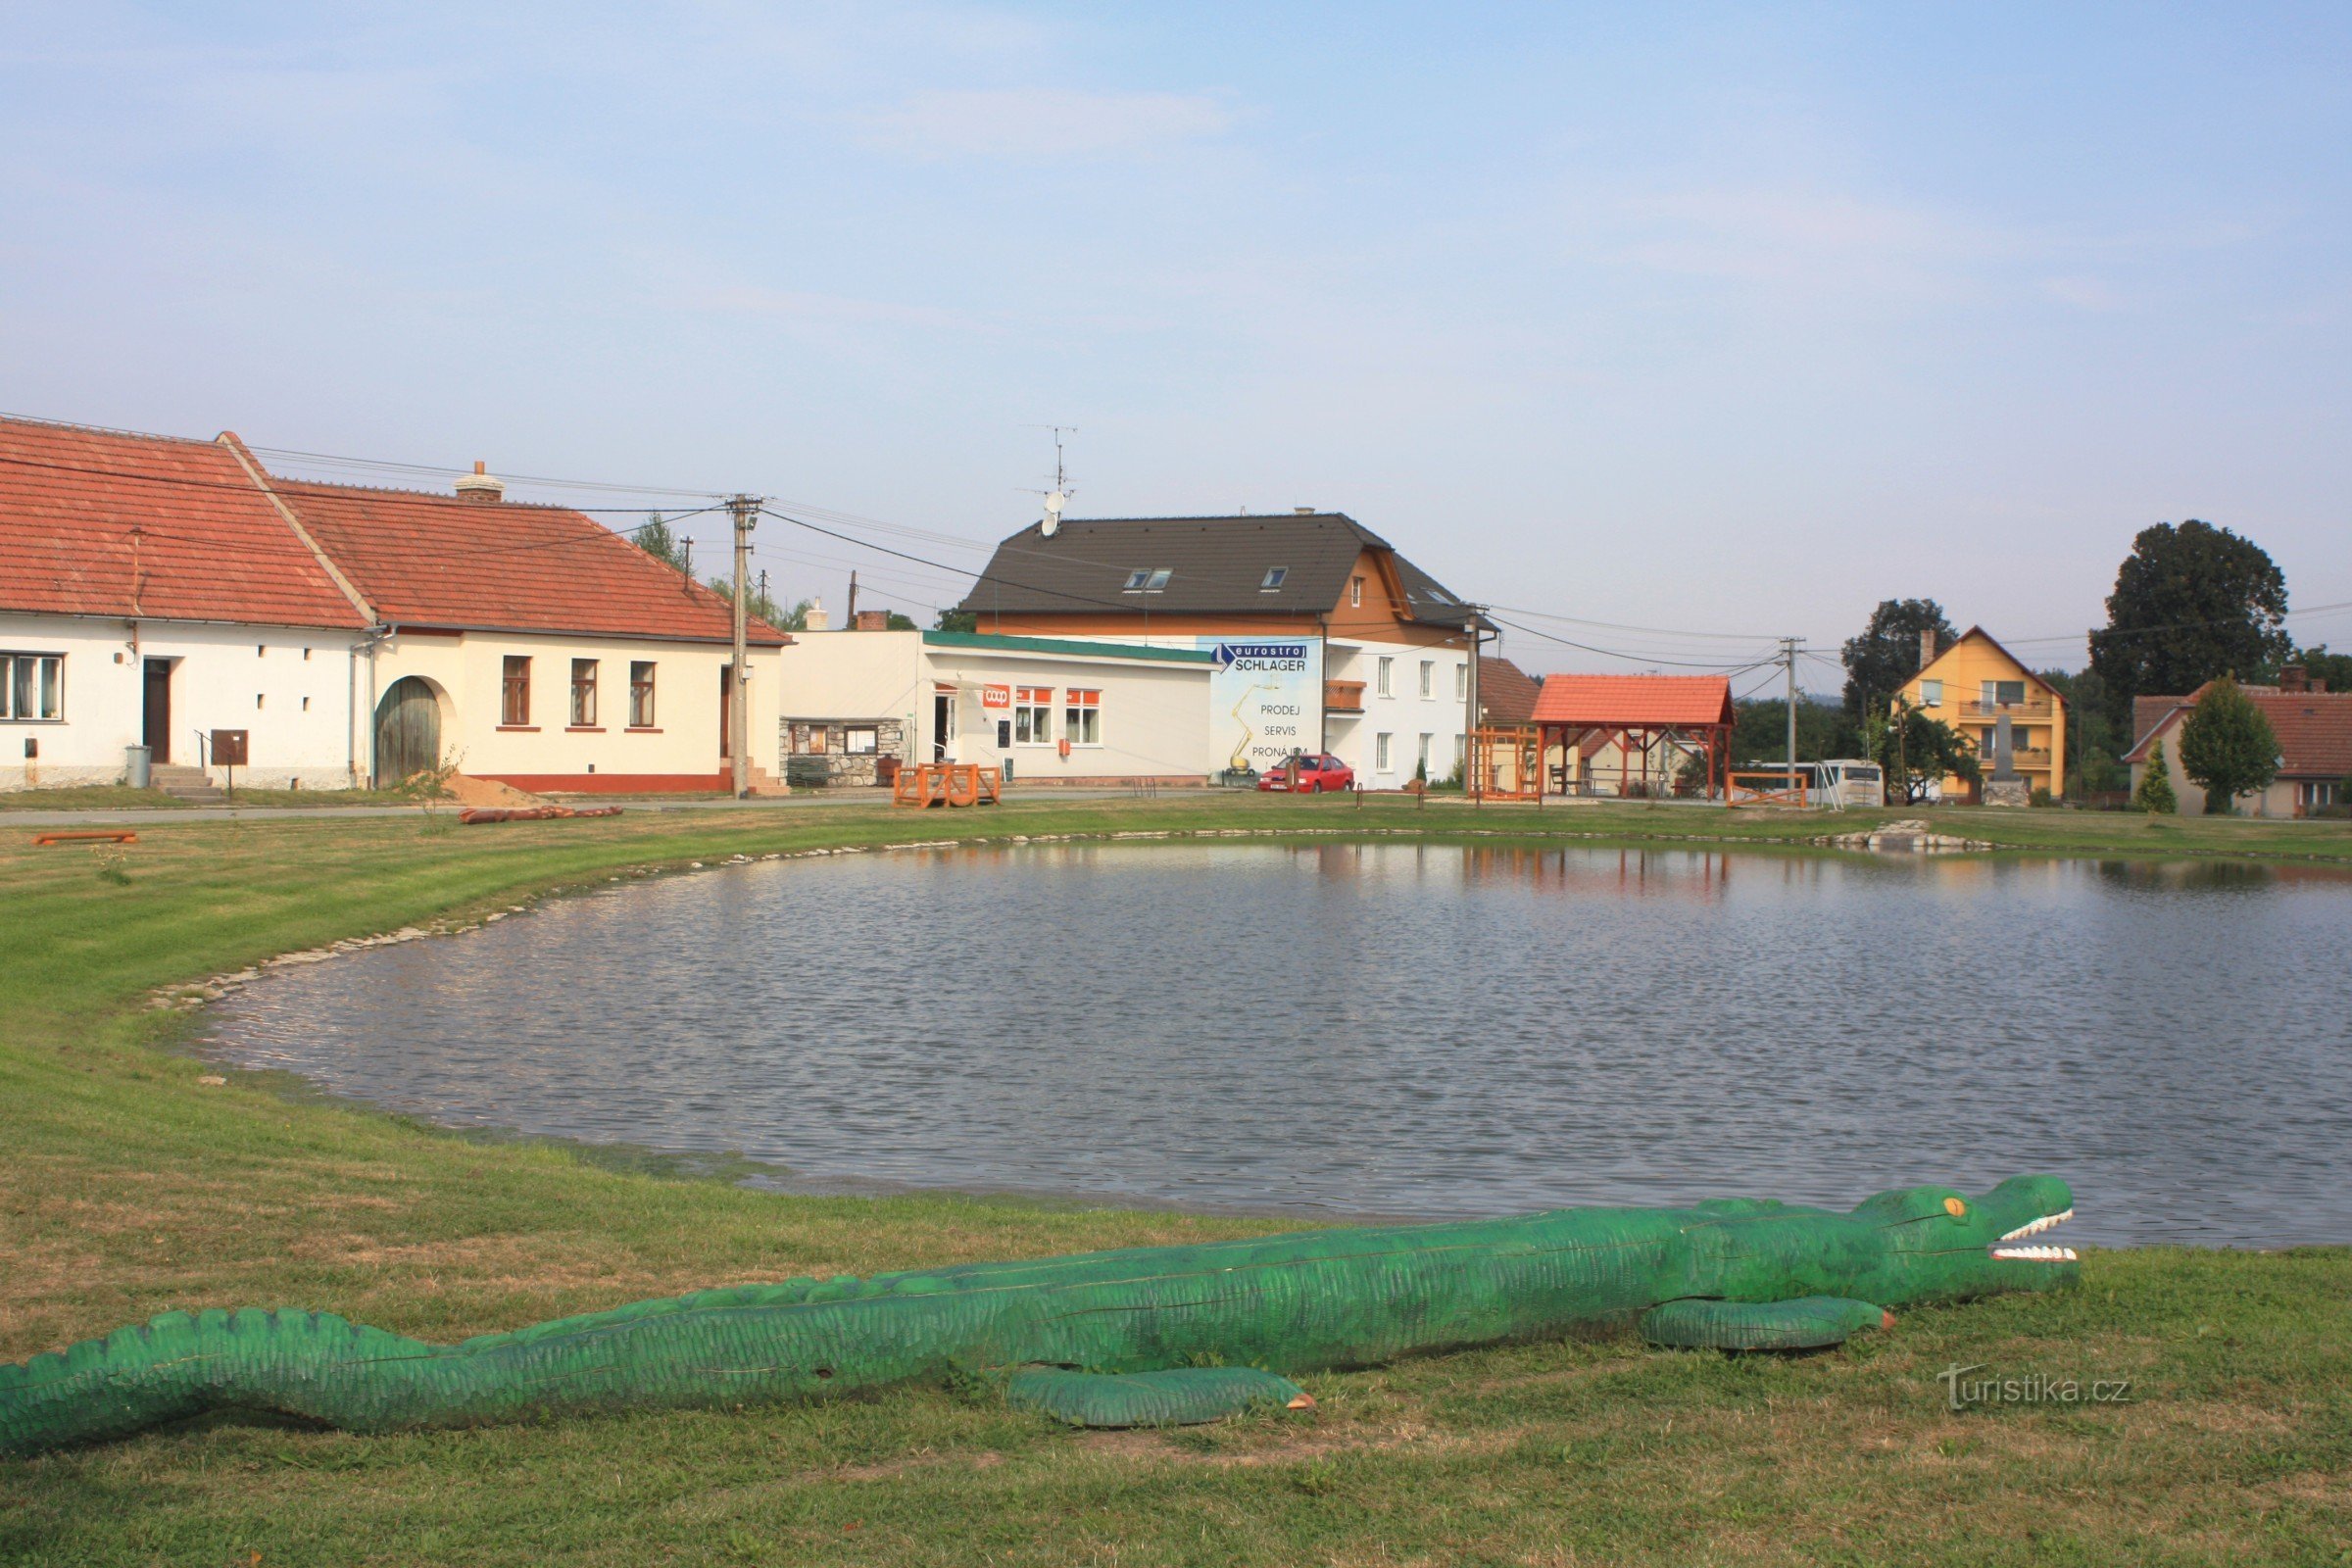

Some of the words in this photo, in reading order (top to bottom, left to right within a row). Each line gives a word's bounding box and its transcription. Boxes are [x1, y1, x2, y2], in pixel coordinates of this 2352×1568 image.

[1235, 646, 1306, 658] eurostroj
[1235, 660, 1305, 671] SCHLAGER
[1260, 705, 1300, 715] PRODEJ
[1264, 725, 1297, 736] SERVIS
